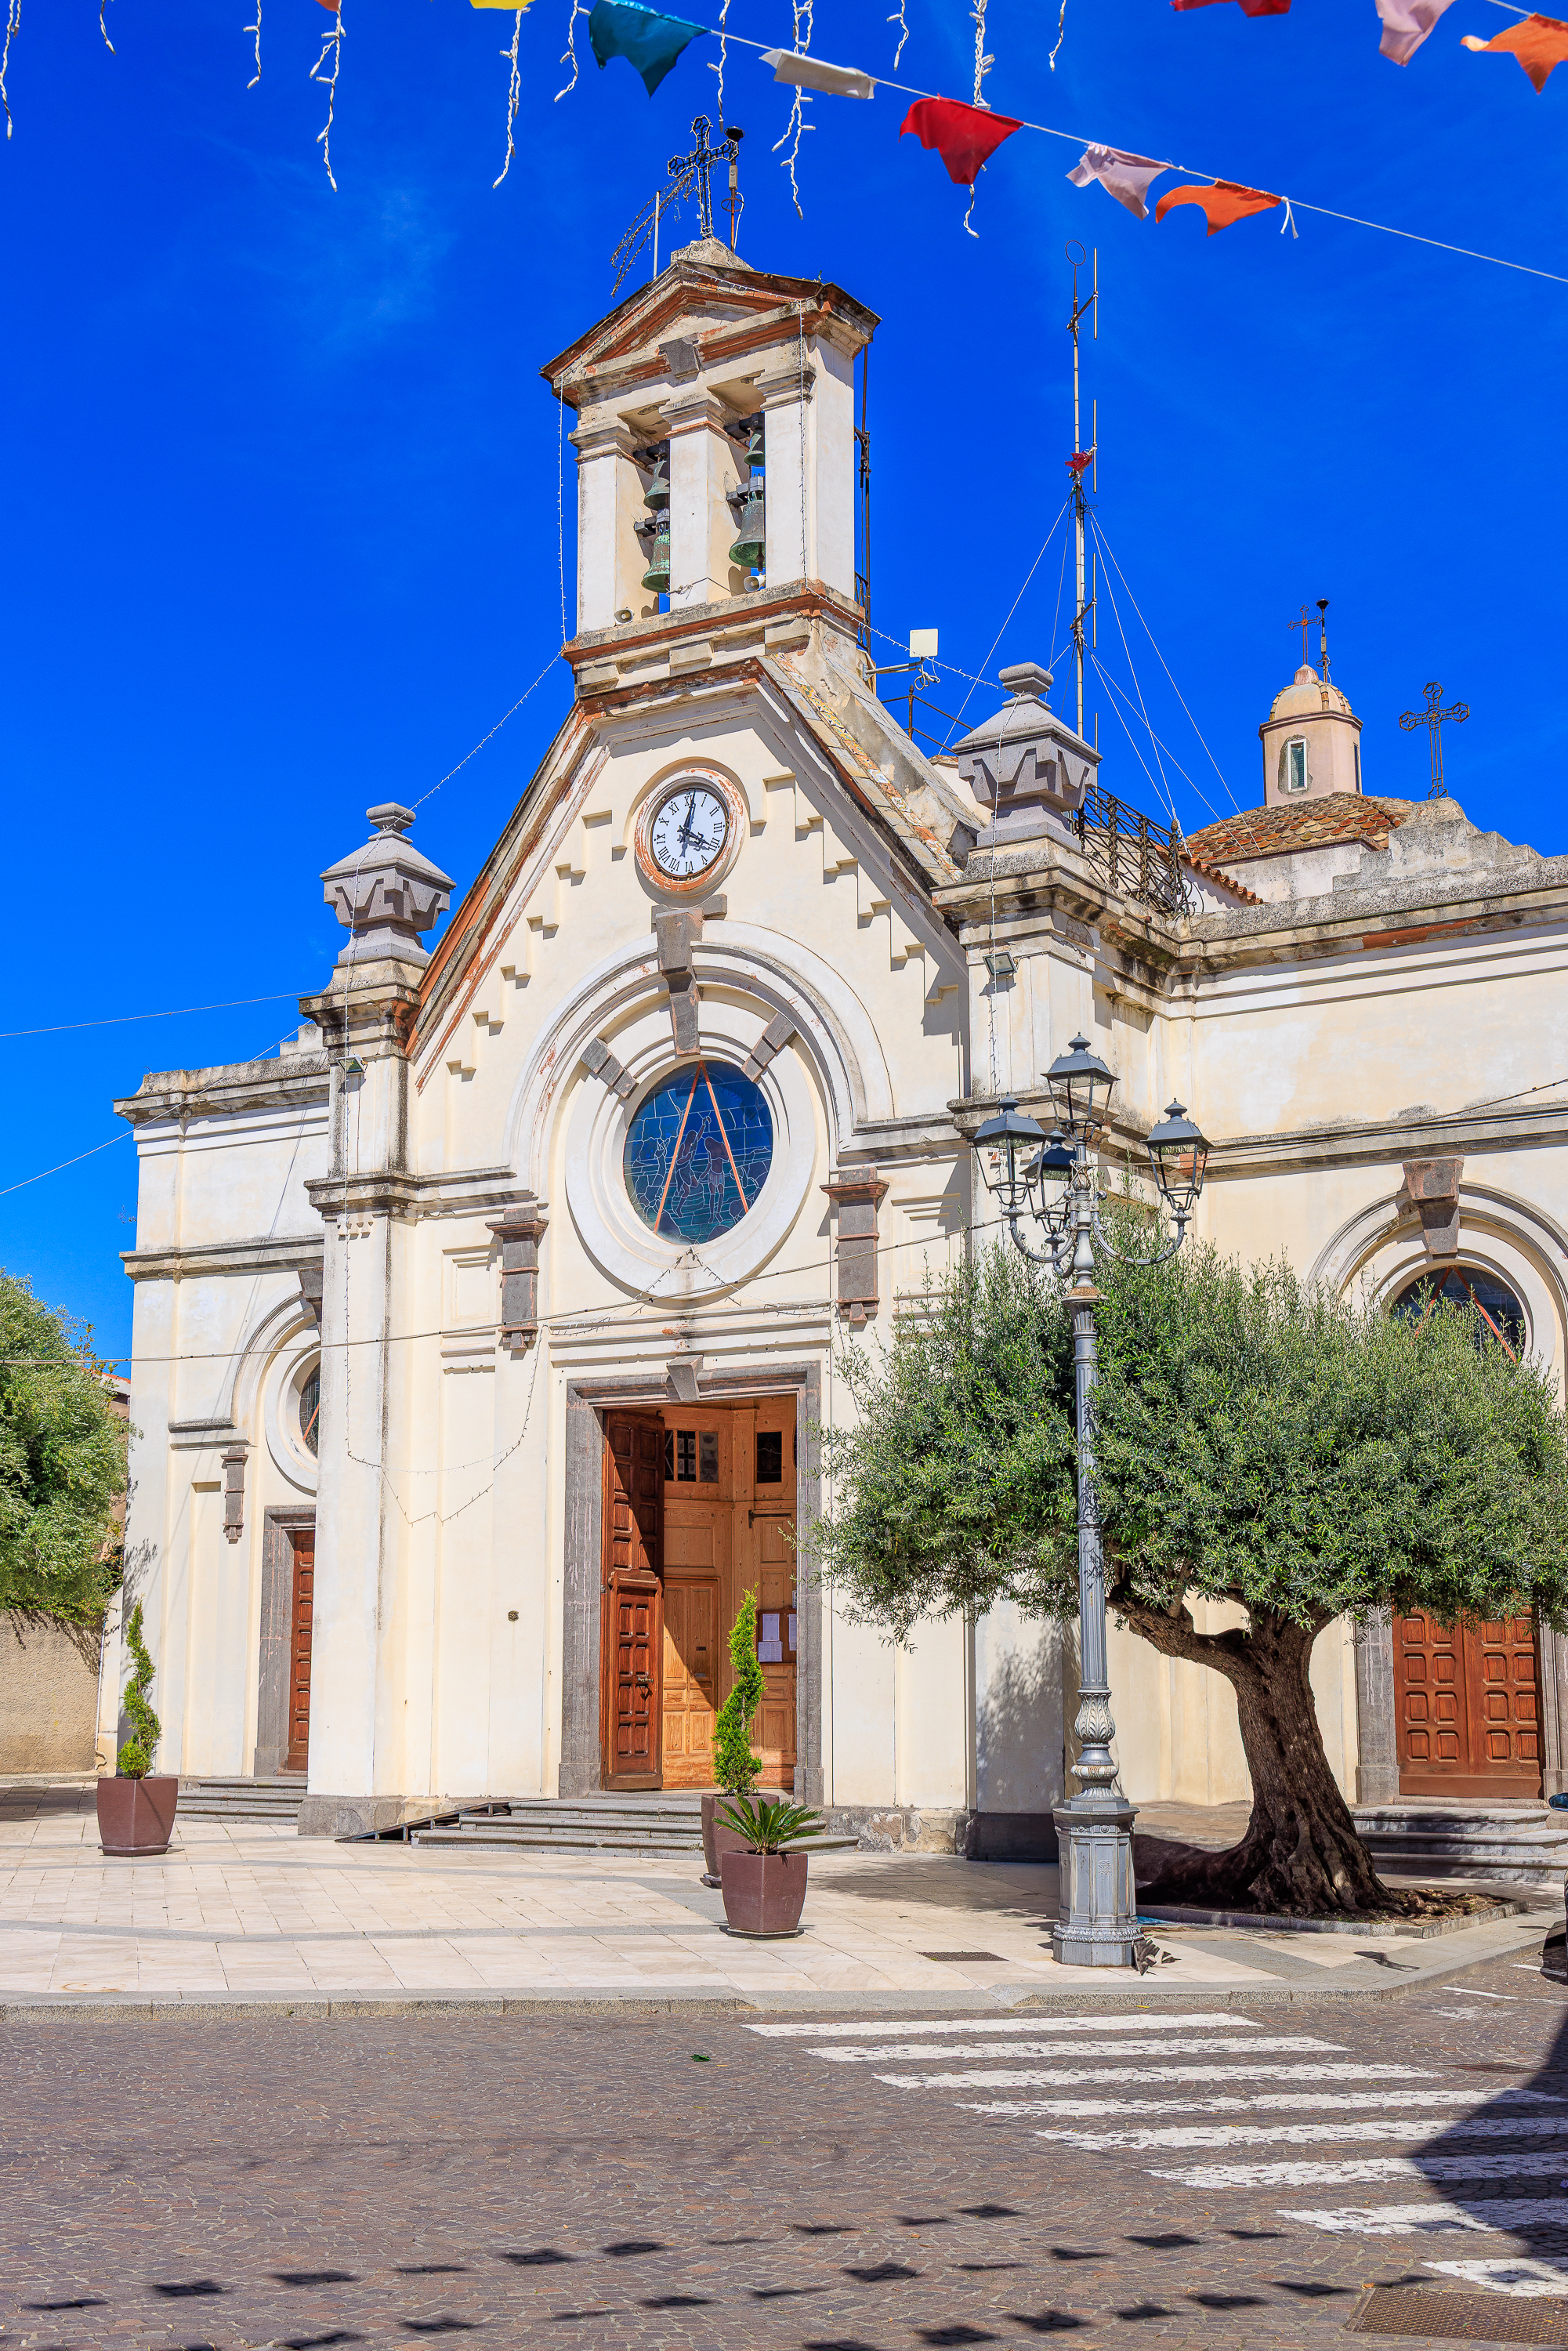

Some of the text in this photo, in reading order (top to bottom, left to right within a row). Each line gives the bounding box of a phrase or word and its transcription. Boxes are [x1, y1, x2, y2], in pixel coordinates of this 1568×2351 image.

[701, 795, 706, 807] I
[668, 802, 679, 816] XI
[709, 806, 719, 817] II
[660, 817, 669, 826] X
[657, 833, 665, 844] IX
[658, 846, 671, 864] VIII
[701, 855, 708, 864] V
[668, 857, 679, 871] VII
[685, 861, 693, 871] VI
